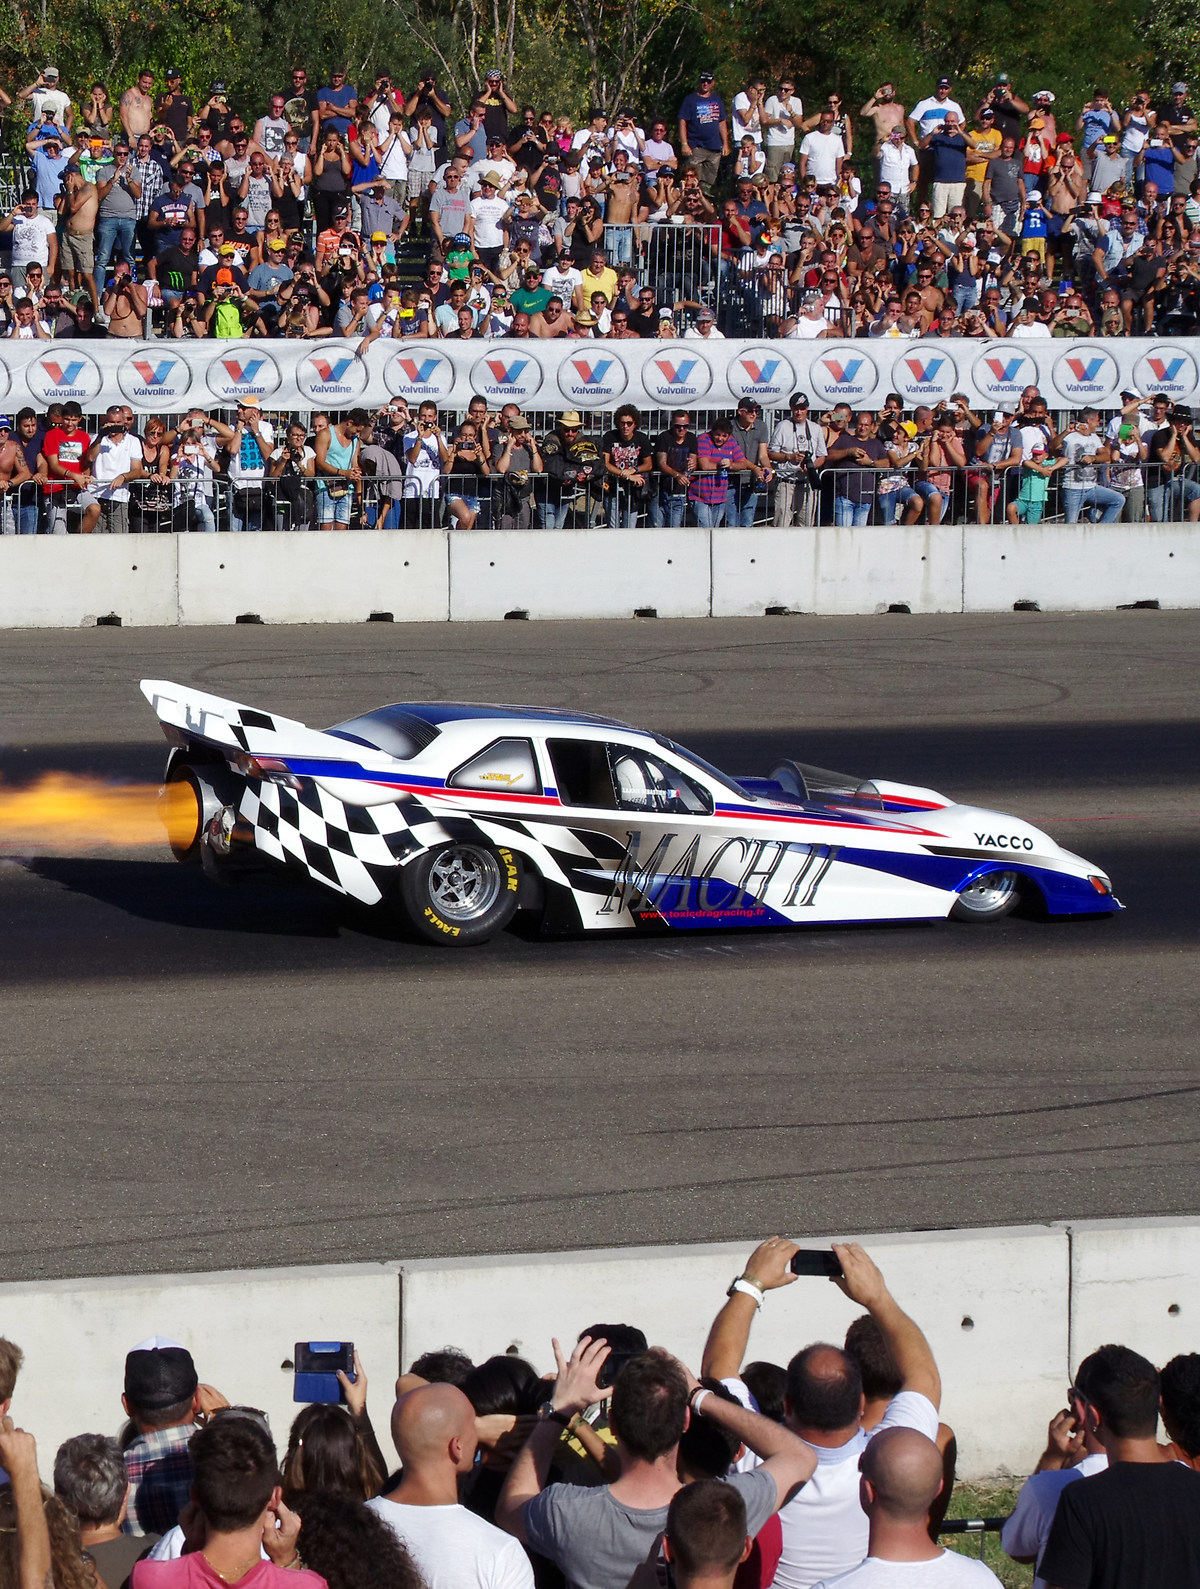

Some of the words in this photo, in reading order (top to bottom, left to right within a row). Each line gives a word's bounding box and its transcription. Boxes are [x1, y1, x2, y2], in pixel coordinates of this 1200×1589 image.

[161, 203, 188, 213] ENGLAND
[43, 388, 87, 397] Valvoline
[133, 387, 175, 396] Valvoline
[222, 385, 266, 395] Valvoline
[309, 384, 353, 393] Valvoline
[399, 385, 440, 394] Valvoline
[484, 385, 527, 395] Valvoline
[571, 385, 613, 395] Valvoline
[656, 385, 697, 395] Valvoline
[741, 385, 782, 394] Valvoline
[824, 384, 864, 393] Valvoline
[904, 384, 944, 393] Valvoline
[987, 383, 1026, 393] Valvoline
[1065, 383, 1105, 393] Valvoline
[1147, 383, 1185, 392] Valvoline
[974, 833, 1033, 851] YACCO
[596, 831, 789, 915] MACH
[640, 908, 766, 919] www.toxicdragracing.fr
[424, 906, 462, 937] EAGLE
